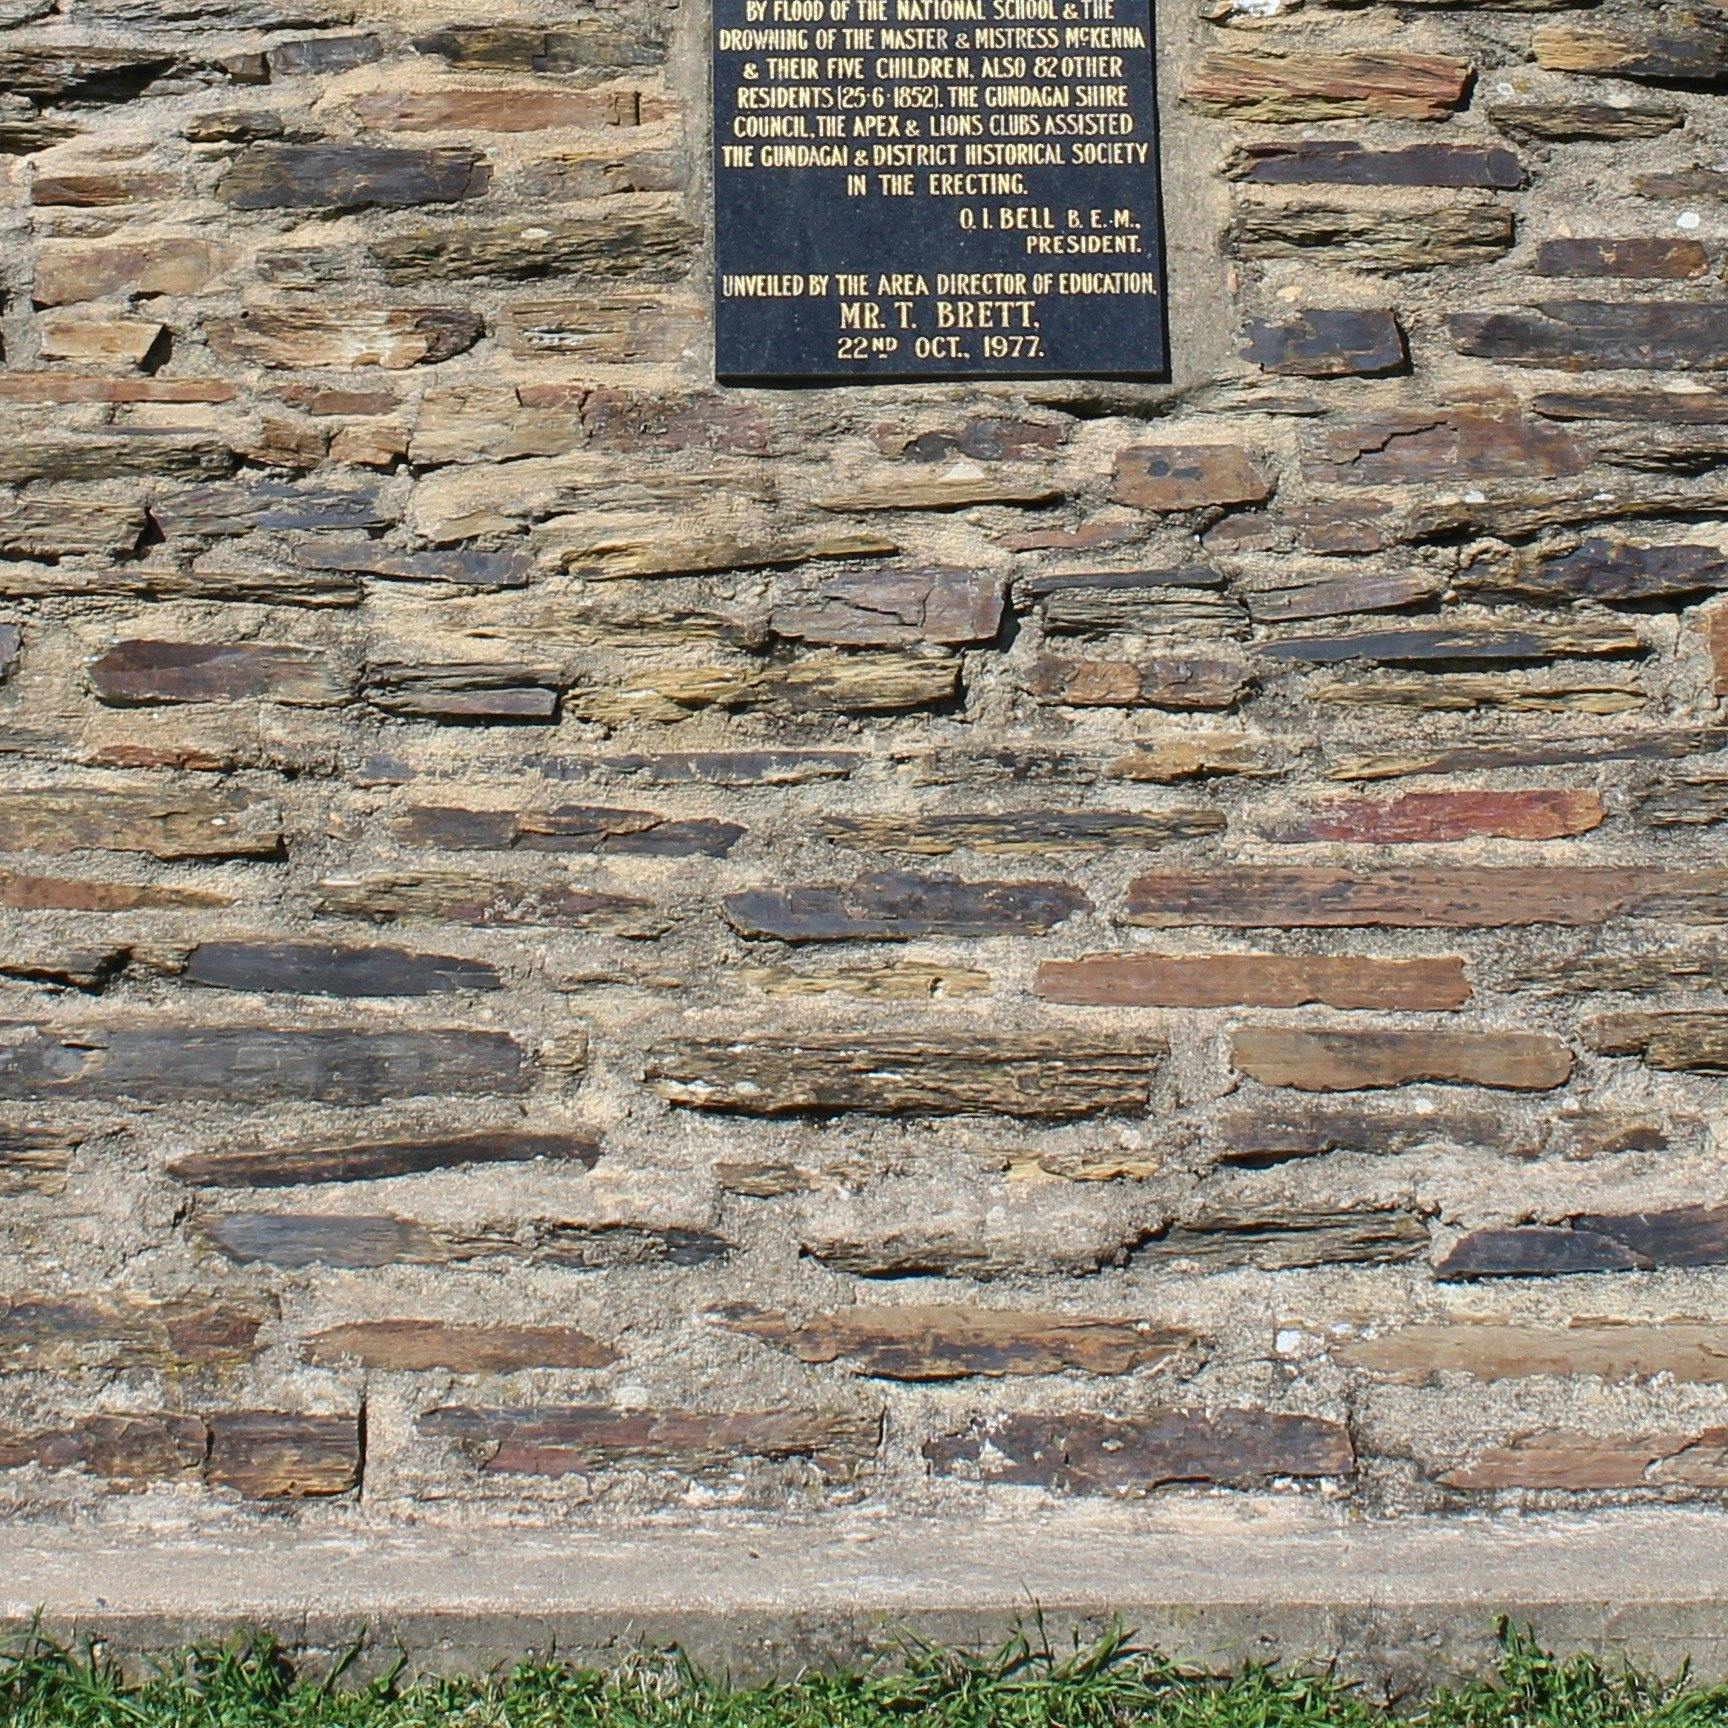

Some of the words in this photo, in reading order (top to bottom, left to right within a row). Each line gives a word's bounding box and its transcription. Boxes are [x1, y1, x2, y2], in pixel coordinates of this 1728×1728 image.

[746, 0, 767, 21] BY
[773, 0, 824, 21] FLOOD
[830, 0, 850, 20] OF
[857, 0, 887, 21] THE
[897, 0, 986, 20] NATIONAL
[993, 0, 1057, 20] SCHOOL
[1063, 3, 1079, 19] &
[1081, 0, 1114, 19] THE
[719, 29, 808, 51] DROWNING
[816, 29, 836, 50] OF
[842, 28, 874, 50] THE
[881, 28, 948, 49] MASTER
[955, 33, 970, 49] &
[975, 28, 1059, 49] MISTRESS
[743, 63, 759, 79] &
[766, 58, 818, 80] THEIR
[827, 58, 864, 79] FIVE
[982, 57, 1026, 78] ALSO
[1033, 57, 1058, 78] 82
[1061, 57, 1123, 77] OTHER
[738, 87, 834, 109] RESIDENTS
[947, 86, 978, 107] THE
[985, 86, 1069, 107] GUNDAGAI
[1075, 86, 1128, 107] SHIRE
[816, 116, 845, 137] THE
[853, 115, 900, 137] APEX
[905, 120, 920, 137] &
[930, 115, 983, 136] LIONS
[989, 114, 1041, 136] CLUBS
[1045, 114, 1133, 135] ASSISTED
[722, 146, 753, 167] THE
[761, 145, 848, 167] GUNDAGAI
[853, 150, 869, 166] &
[873, 144, 958, 166] DISTRICT
[966, 143, 1064, 165] HISTORICAL
[1072, 143, 1148, 164] SOCIETY
[848, 175, 866, 196] IN
[879, 174, 914, 195] THE
[930, 173, 1027, 195] ERECTING.
[1000, 207, 1054, 229] BELL
[1027, 235, 1141, 254] PRESIDENT.
[723, 275, 804, 296] UNVEILED
[809, 275, 829, 295] BY
[836, 274, 869, 296] THE
[878, 274, 929, 295] AREA
[937, 273, 1026, 295] DIRECTOR
[1033, 273, 1053, 294] OF
[840, 302, 885, 329] MR.
[894, 302, 916, 328] T.
[984, 336, 1044, 357] 1977.
